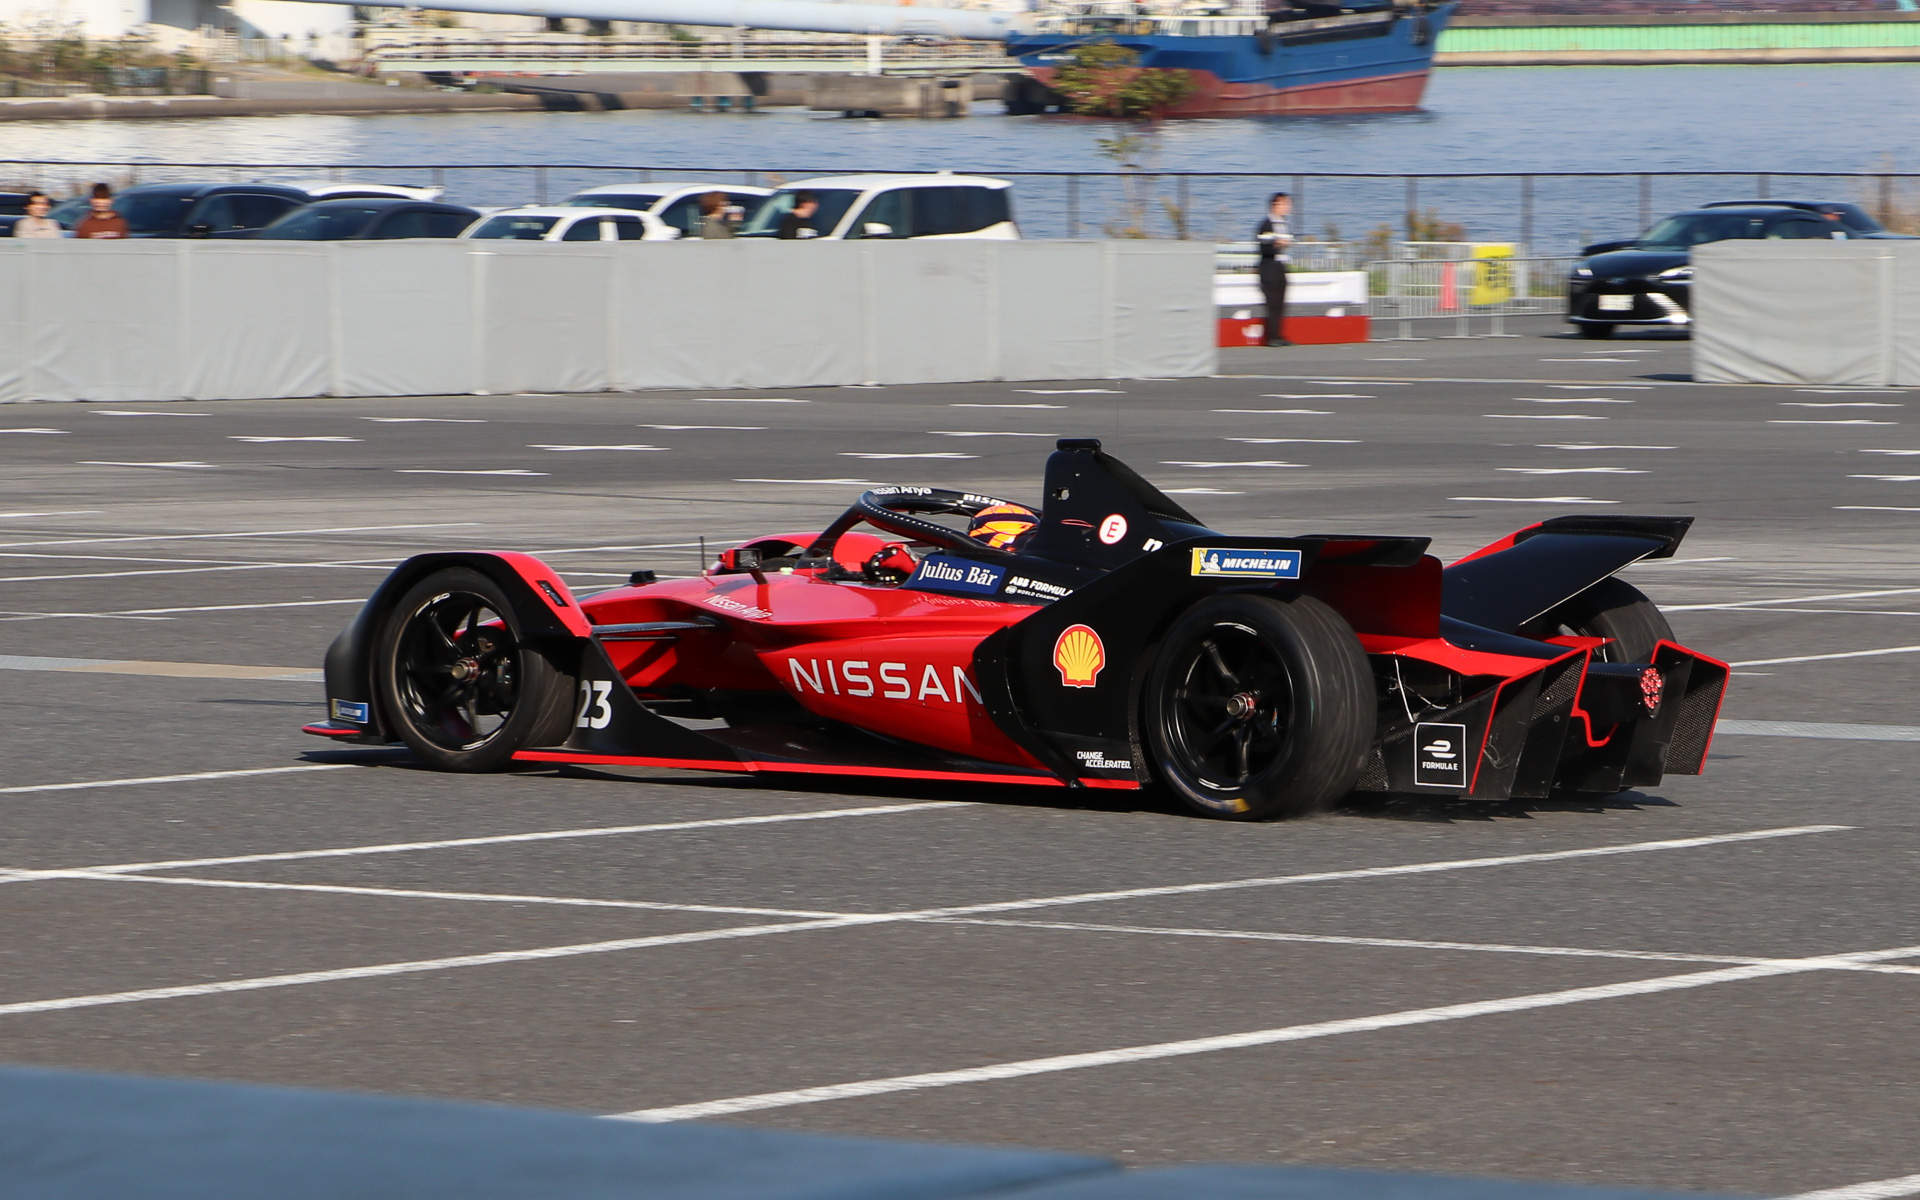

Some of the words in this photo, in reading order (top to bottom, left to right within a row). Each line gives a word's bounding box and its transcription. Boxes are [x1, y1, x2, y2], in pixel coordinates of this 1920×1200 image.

[1106, 521, 1120, 538] E
[1222, 557, 1291, 570] MICHELIN
[918, 560, 964, 582] Julius
[965, 566, 998, 586] Bär
[1009, 575, 1030, 588] ABB
[1017, 589, 1036, 597] WORLD
[788, 658, 984, 705] NISSAN
[576, 679, 613, 730] 23
[1085, 759, 1132, 770] ACCELERATED.
[1422, 761, 1453, 771] FORMULA
[1453, 763, 1459, 771] E
